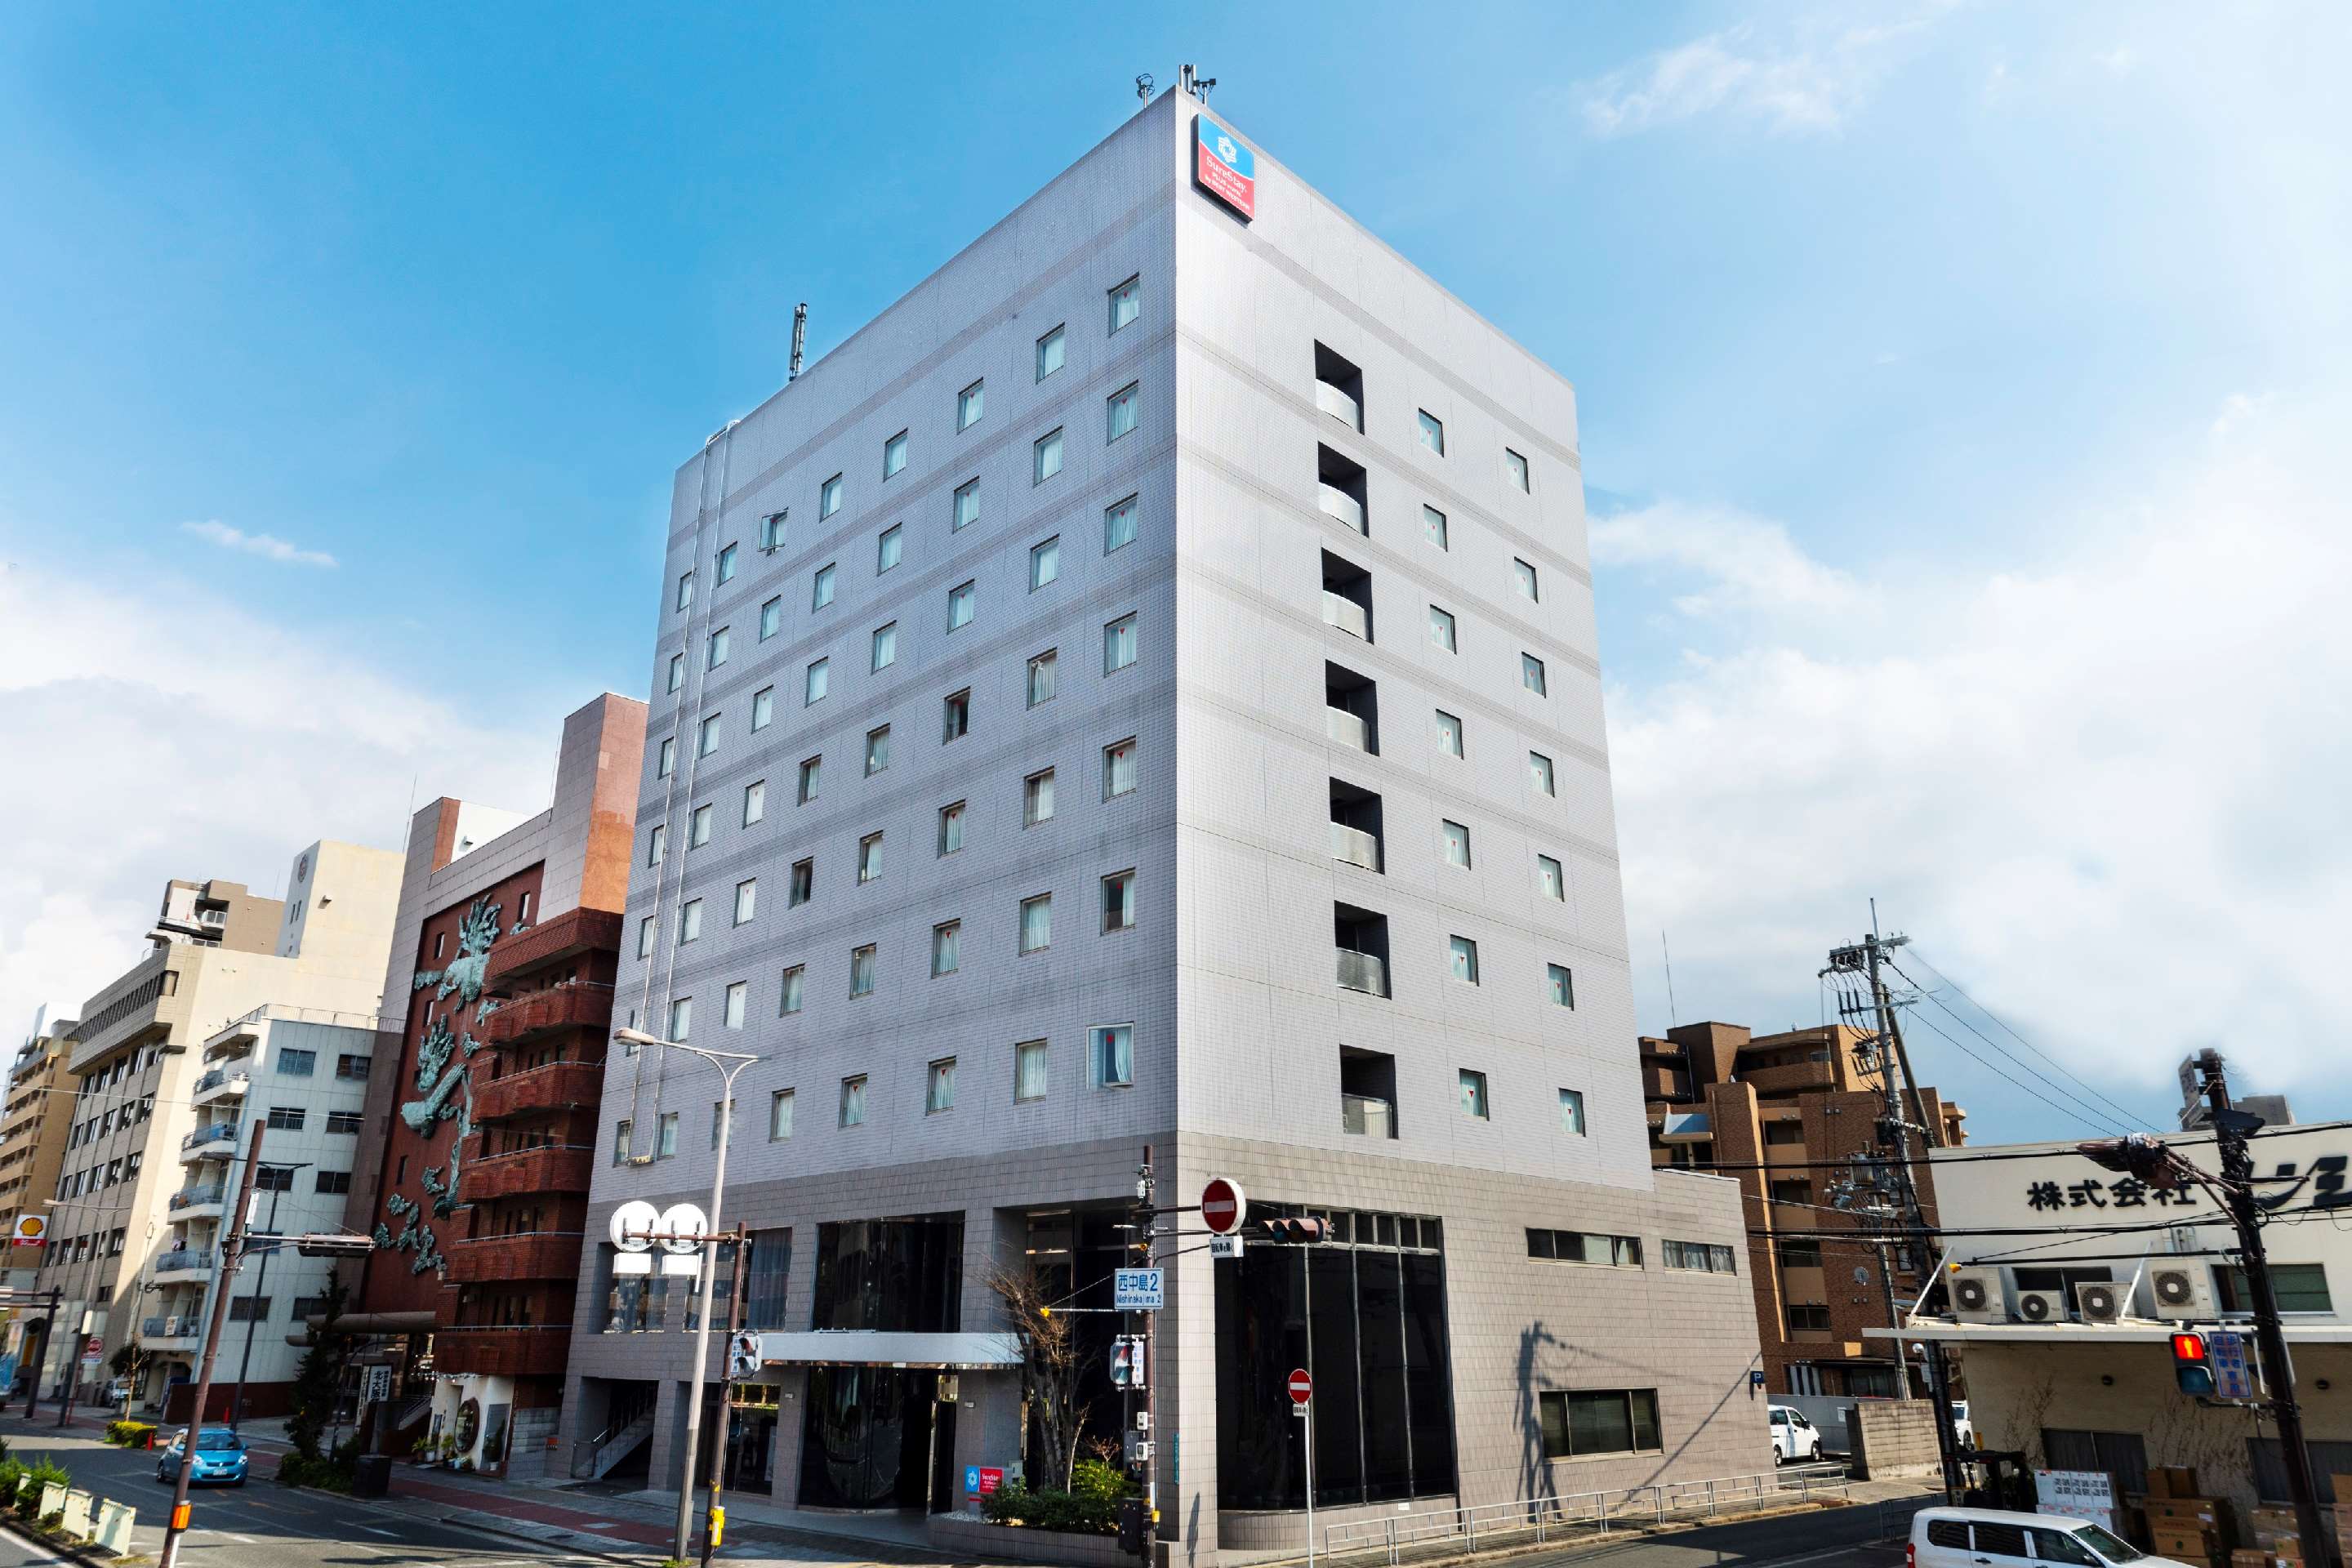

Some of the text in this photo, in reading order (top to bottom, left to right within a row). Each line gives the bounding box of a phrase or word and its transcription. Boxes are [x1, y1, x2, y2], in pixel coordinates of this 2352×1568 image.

[1206, 156, 1246, 193] SureStay
[2027, 1178, 2197, 1211] 株式会社
[1118, 1273, 1158, 1291] 西中島2
[1117, 1294, 1161, 1305] Nishinakajima 2
[1754, 1373, 1762, 1382] P
